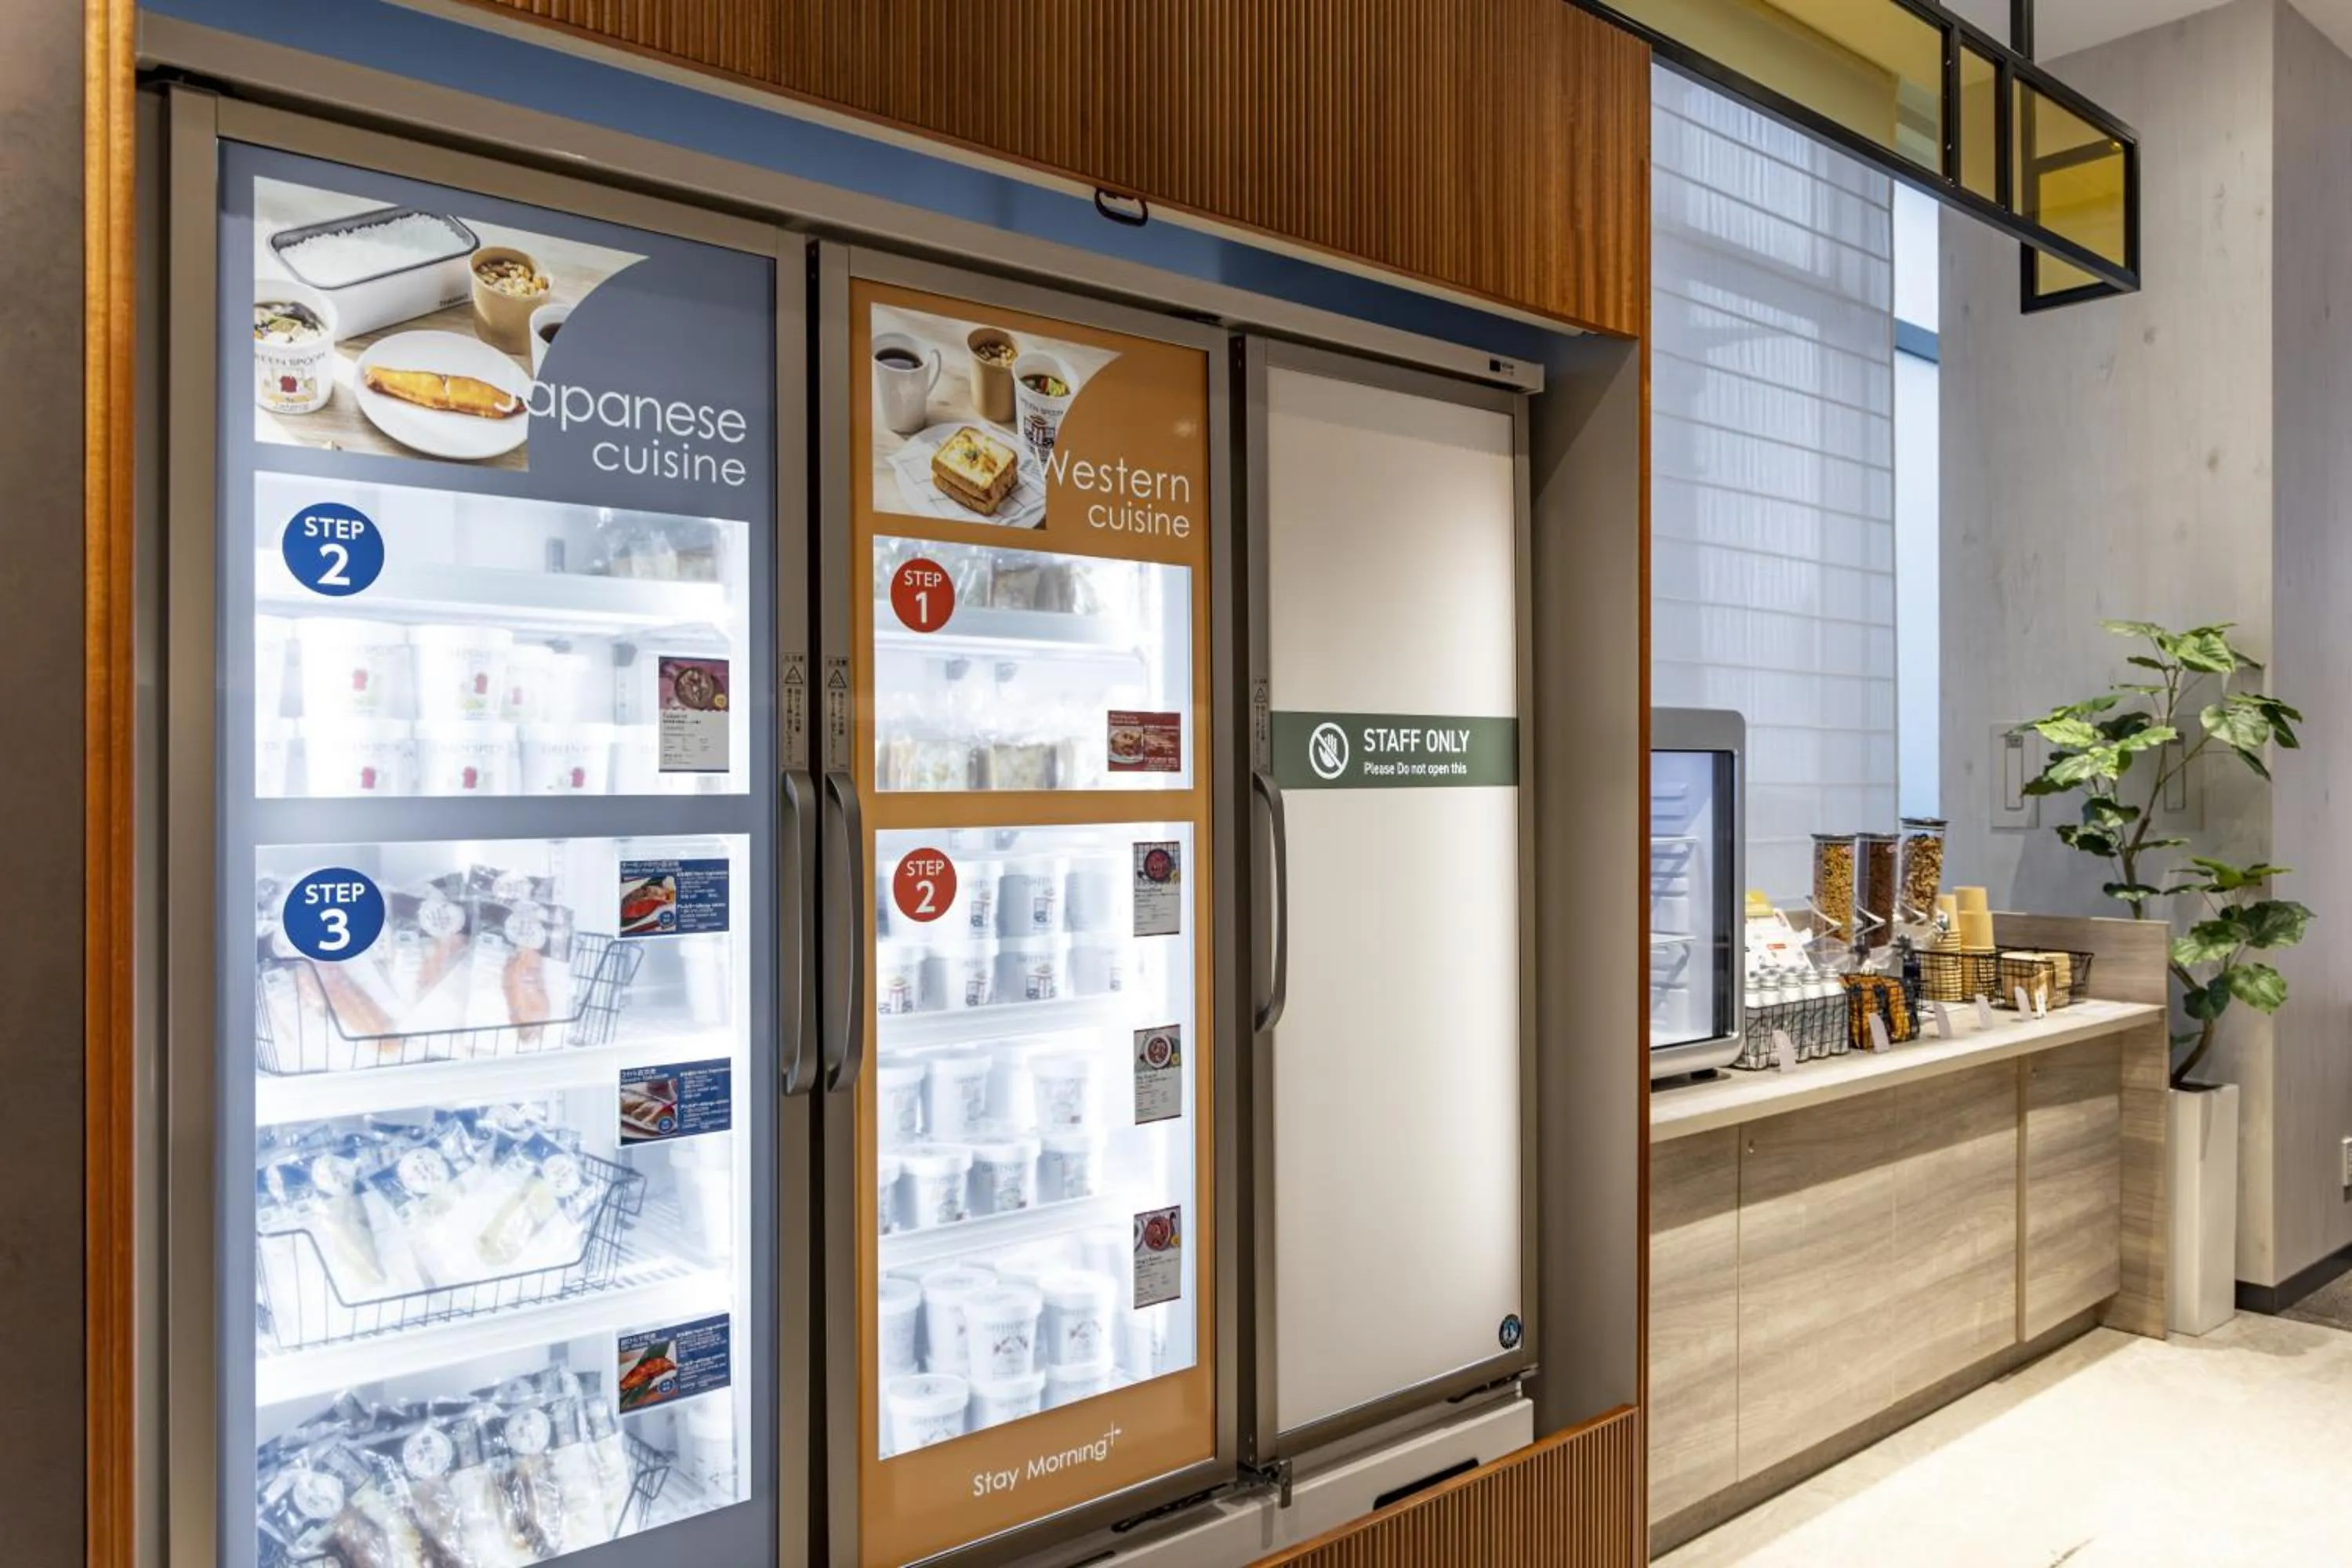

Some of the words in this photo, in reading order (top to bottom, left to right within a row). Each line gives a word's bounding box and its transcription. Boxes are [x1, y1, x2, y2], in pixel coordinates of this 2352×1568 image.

[593, 439, 746, 486] cuisine
[1035, 448, 1190, 503] Western
[303, 516, 365, 539] STEP
[1088, 503, 1190, 538] cuisine
[317, 543, 351, 586] 2
[904, 570, 942, 588] STEP
[915, 592, 928, 624] 1
[1363, 728, 1421, 753] STAFF
[1425, 729, 1471, 753] ONLY
[1363, 761, 1395, 775] Please
[1397, 762, 1410, 775] Do
[1411, 763, 1426, 775] not
[1428, 764, 1450, 777] open
[1451, 762, 1468, 775] this
[906, 859, 945, 877] STEP
[303, 882, 365, 904] STEP
[914, 880, 936, 914] 2
[318, 908, 351, 951] 3
[973, 1467, 1019, 1497] Stay
